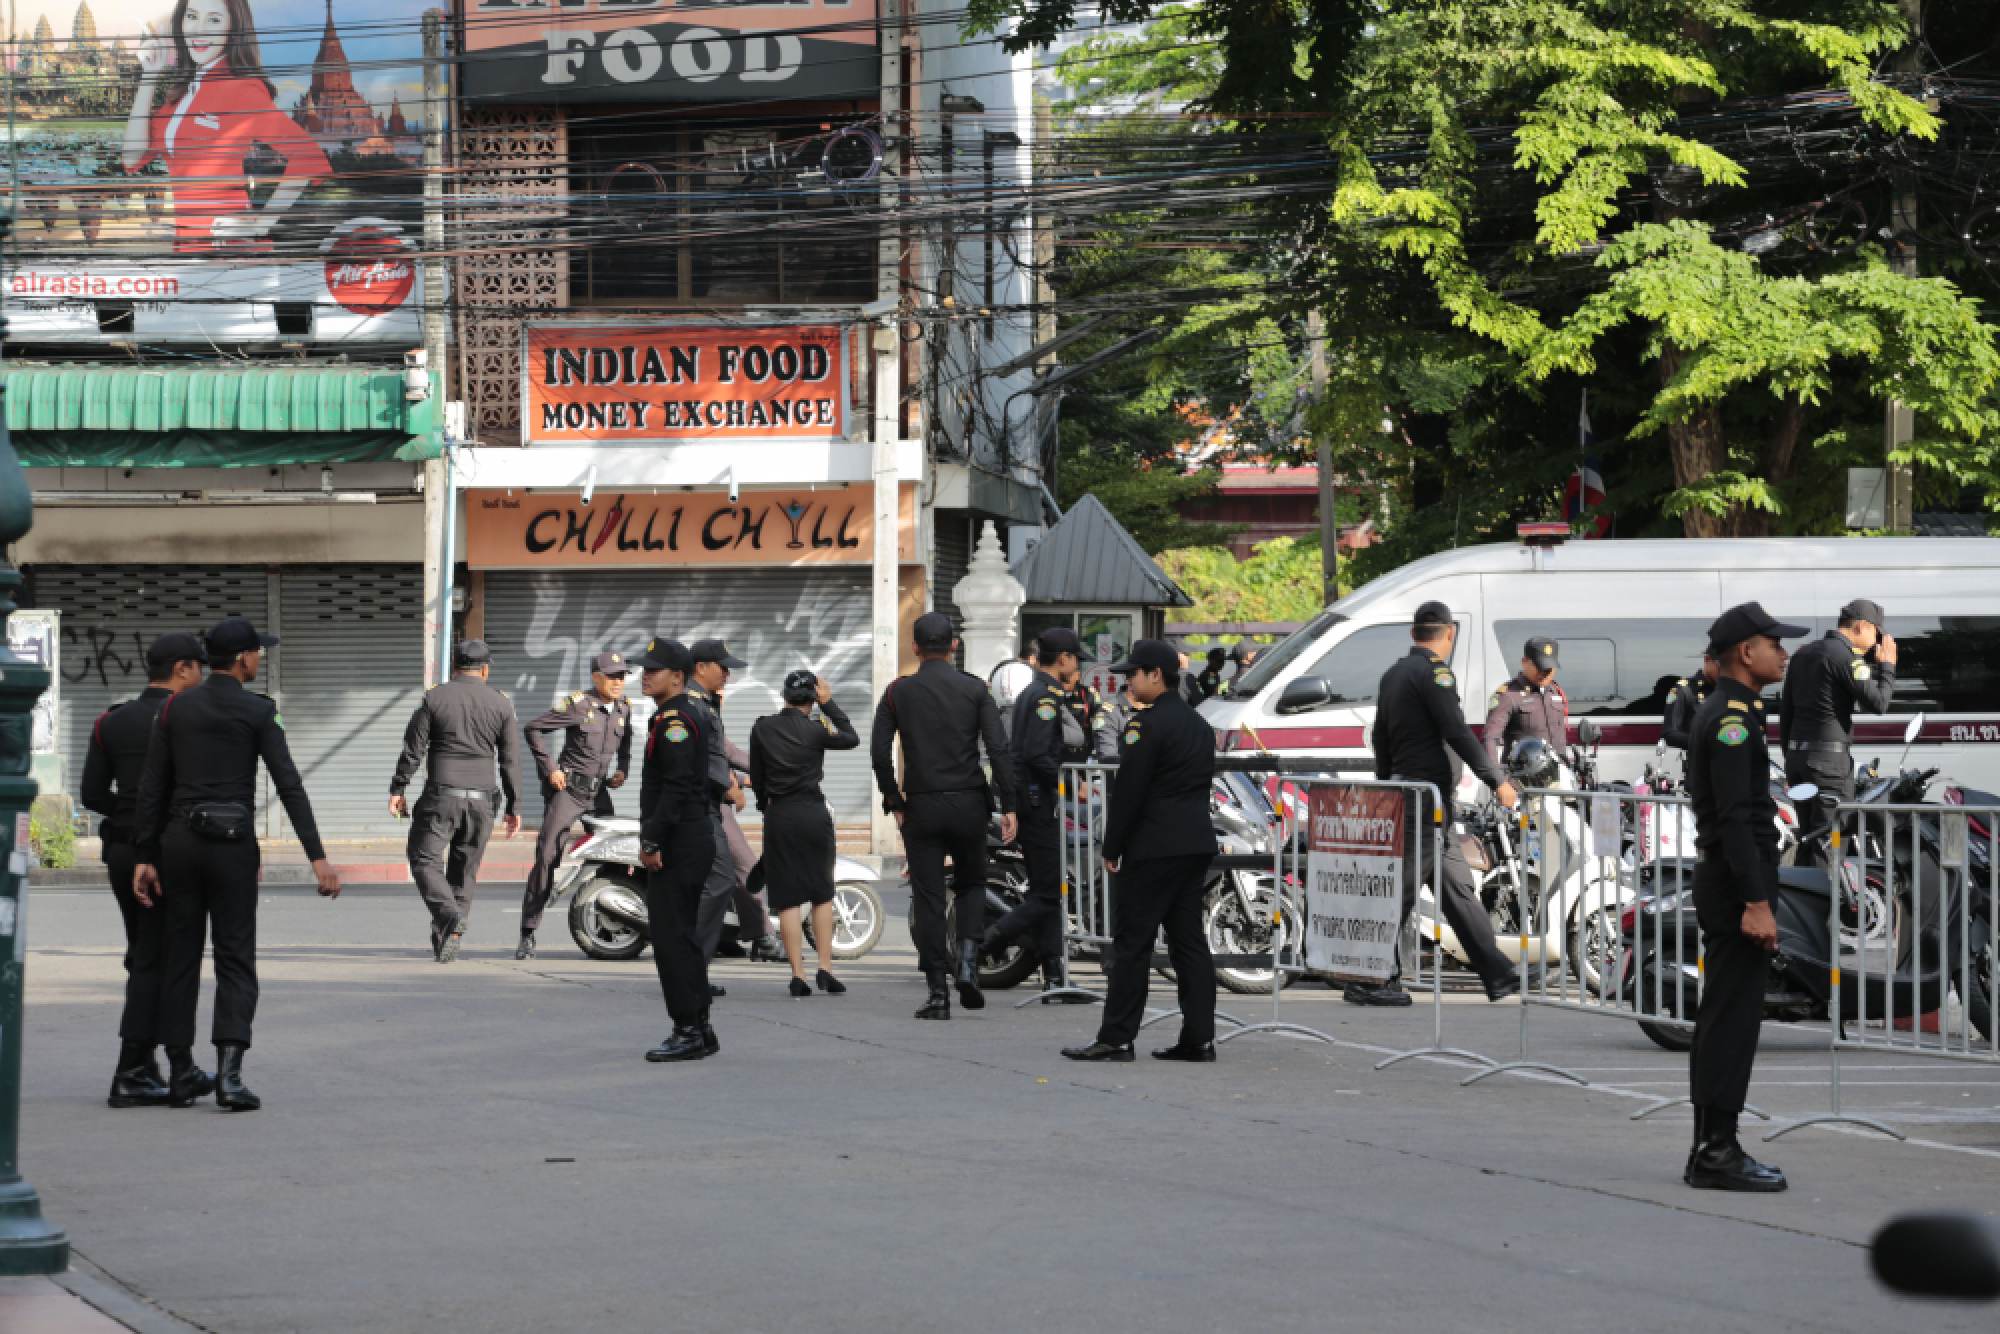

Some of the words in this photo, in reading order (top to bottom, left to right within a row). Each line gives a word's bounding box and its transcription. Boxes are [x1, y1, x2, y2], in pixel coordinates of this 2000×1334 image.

[541, 27, 803, 84] FOOD
[12, 271, 179, 295] airasia.com
[543, 345, 701, 386] INDIAN
[717, 344, 831, 385] FOOD
[541, 401, 652, 431] MONEY
[664, 399, 837, 430] EXCHANGE
